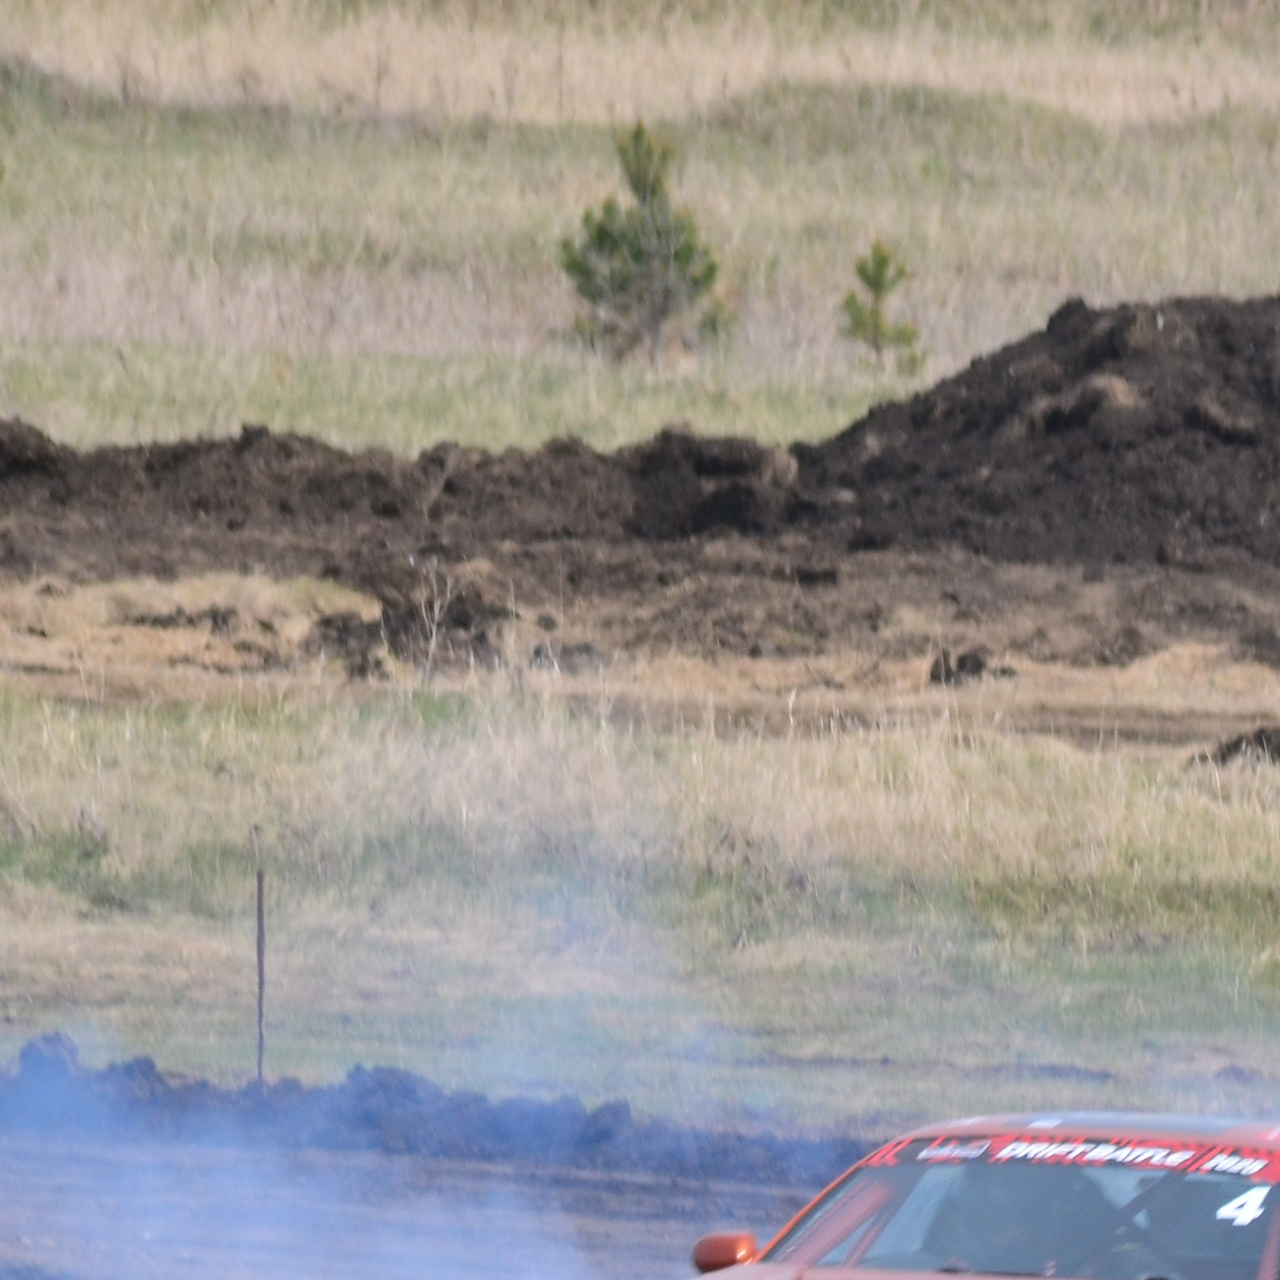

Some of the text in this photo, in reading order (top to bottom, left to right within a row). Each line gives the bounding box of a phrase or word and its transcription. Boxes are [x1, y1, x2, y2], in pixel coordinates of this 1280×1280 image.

[997, 1141, 1096, 1160] DRIFT
[1083, 1144, 1195, 1167] BATTLE
[1215, 1186, 1272, 1227] 4
